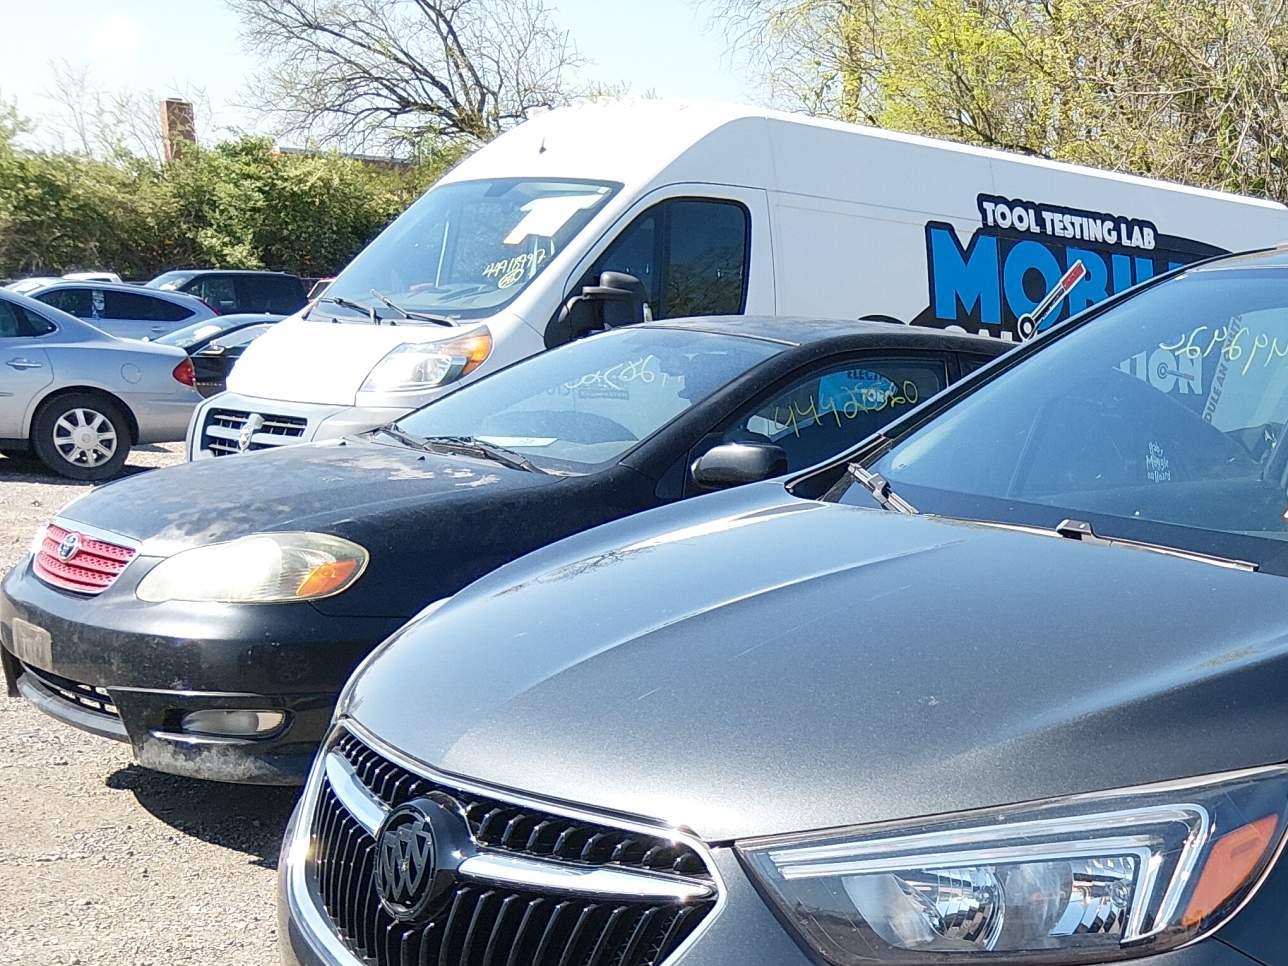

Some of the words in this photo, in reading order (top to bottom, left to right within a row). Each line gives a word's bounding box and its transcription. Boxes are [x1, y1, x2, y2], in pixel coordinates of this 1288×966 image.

[982, 201, 1041, 233] TOOL
[1042, 211, 1118, 244] TESTING
[1121, 223, 1156, 250] LAB
